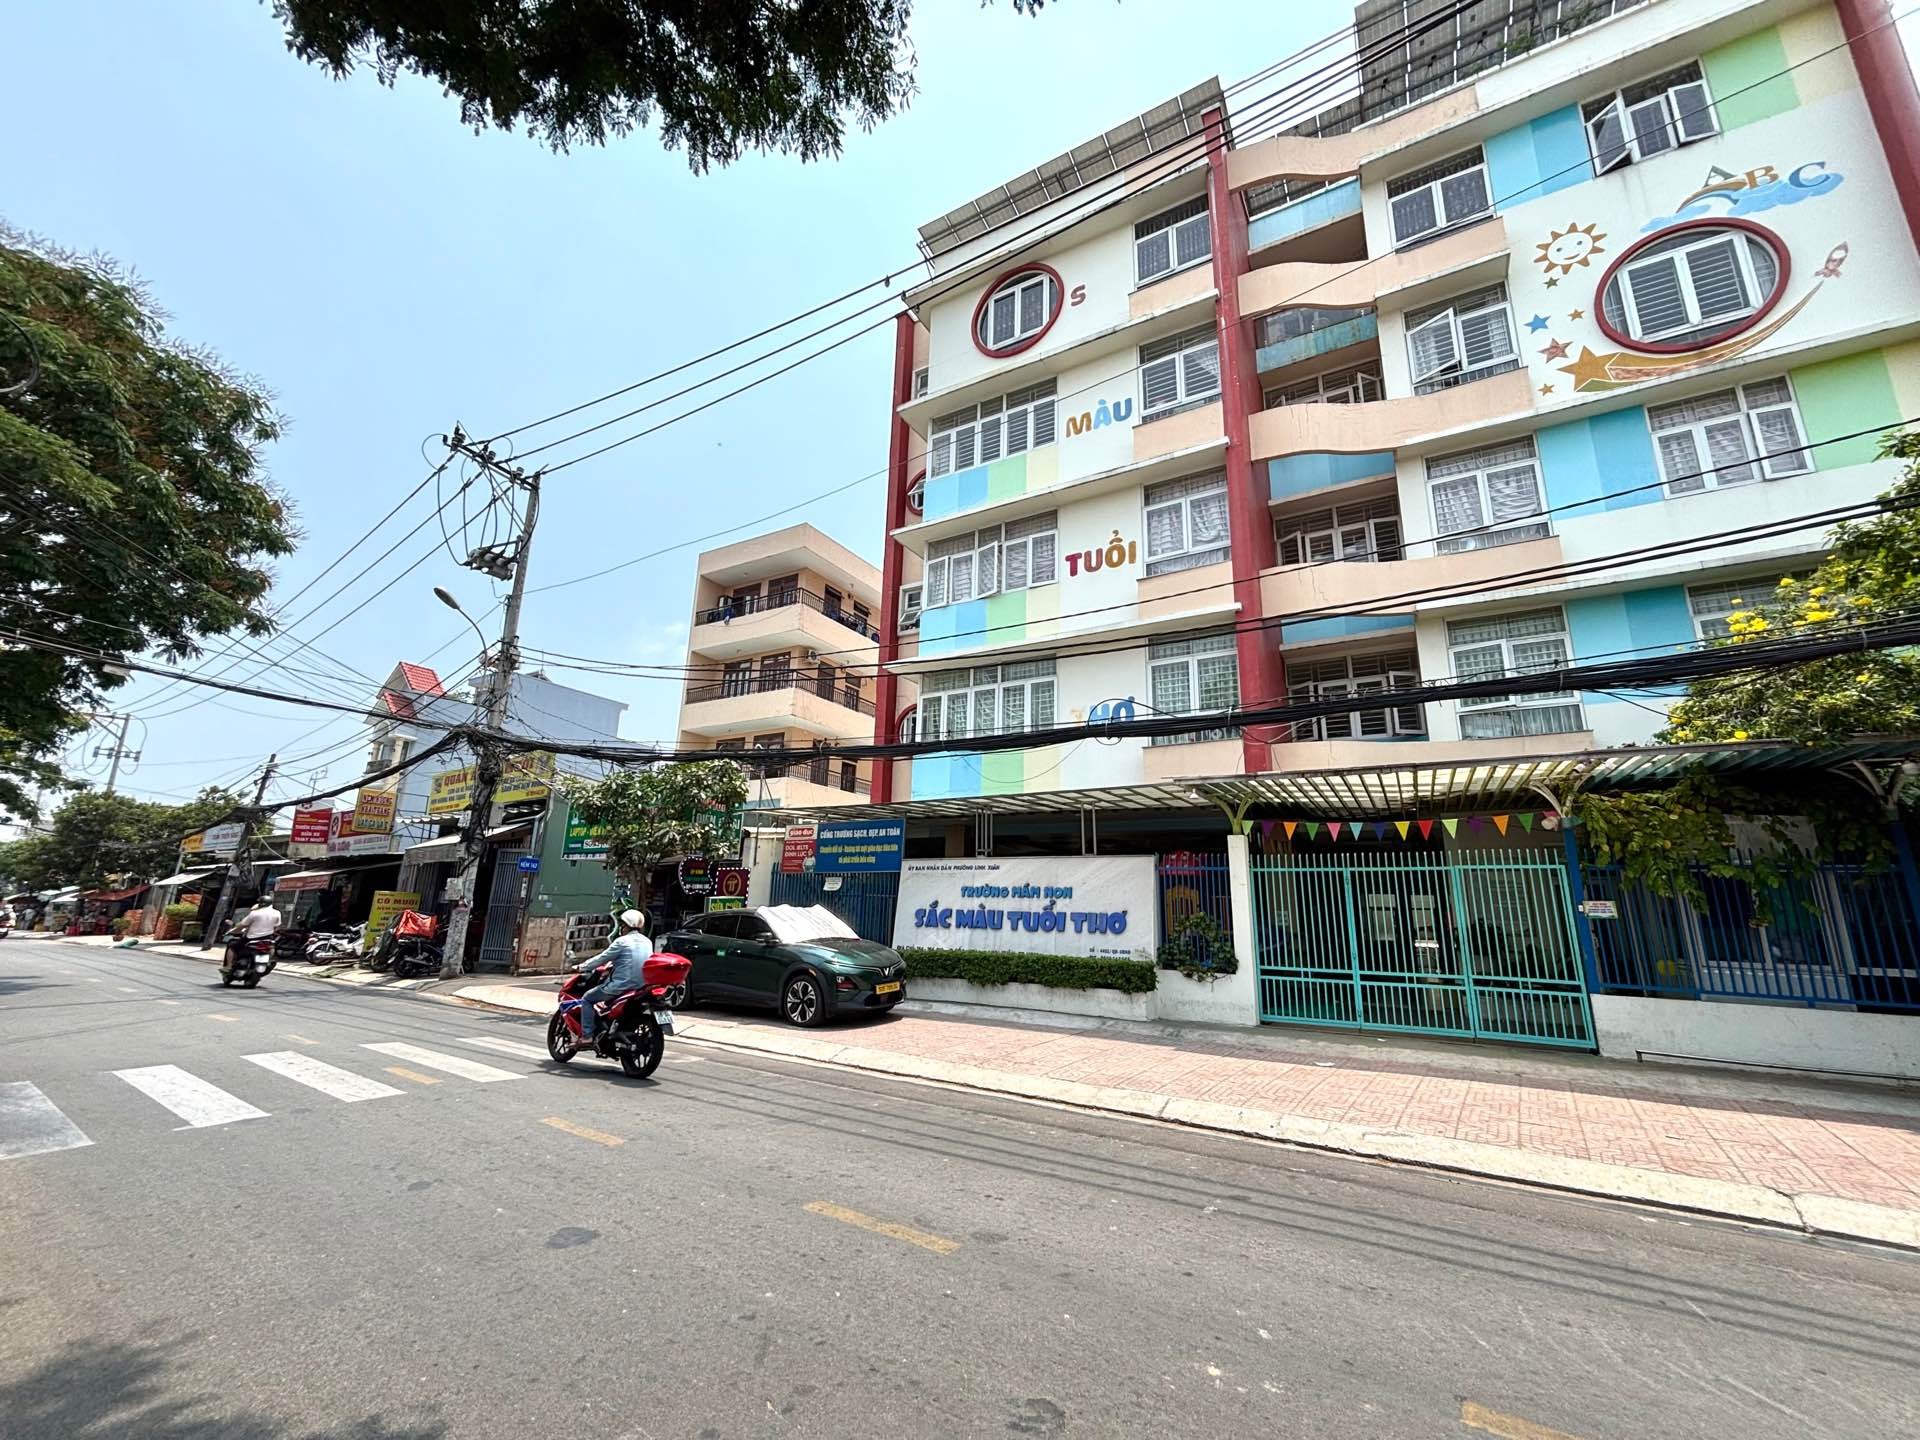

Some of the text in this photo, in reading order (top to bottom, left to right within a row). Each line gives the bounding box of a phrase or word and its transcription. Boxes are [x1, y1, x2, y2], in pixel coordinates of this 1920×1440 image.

[1070, 284, 1086, 307] S
[1066, 397, 1133, 438] MÀU
[1065, 529, 1137, 577] TUỔI
[960, 883, 1009, 899] TRƯỜNG
[1043, 886, 1073, 899] NON
[914, 899, 1128, 935] SẮC MÀU TUỔI THƠ
